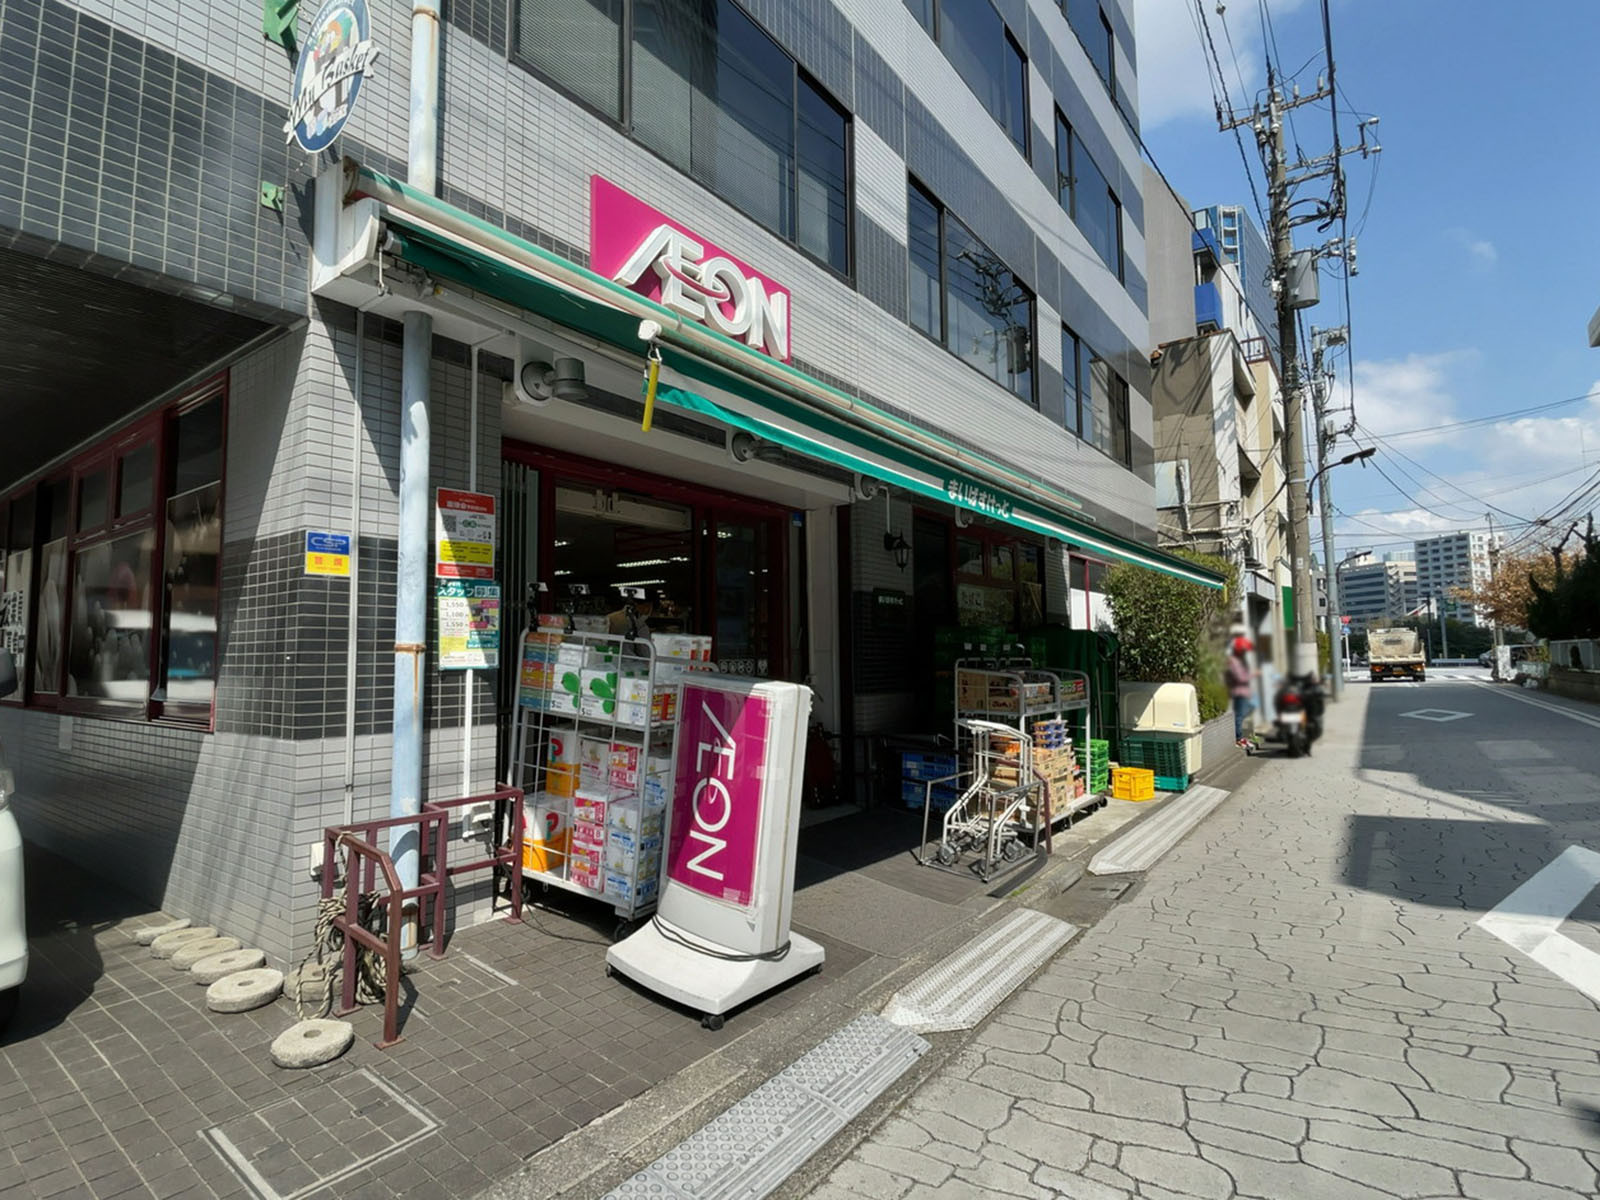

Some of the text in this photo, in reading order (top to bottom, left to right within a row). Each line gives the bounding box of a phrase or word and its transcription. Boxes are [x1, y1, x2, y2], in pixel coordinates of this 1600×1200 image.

[948, 479, 1010, 518] まいばすけっと
[311, 536, 347, 548] CSP
